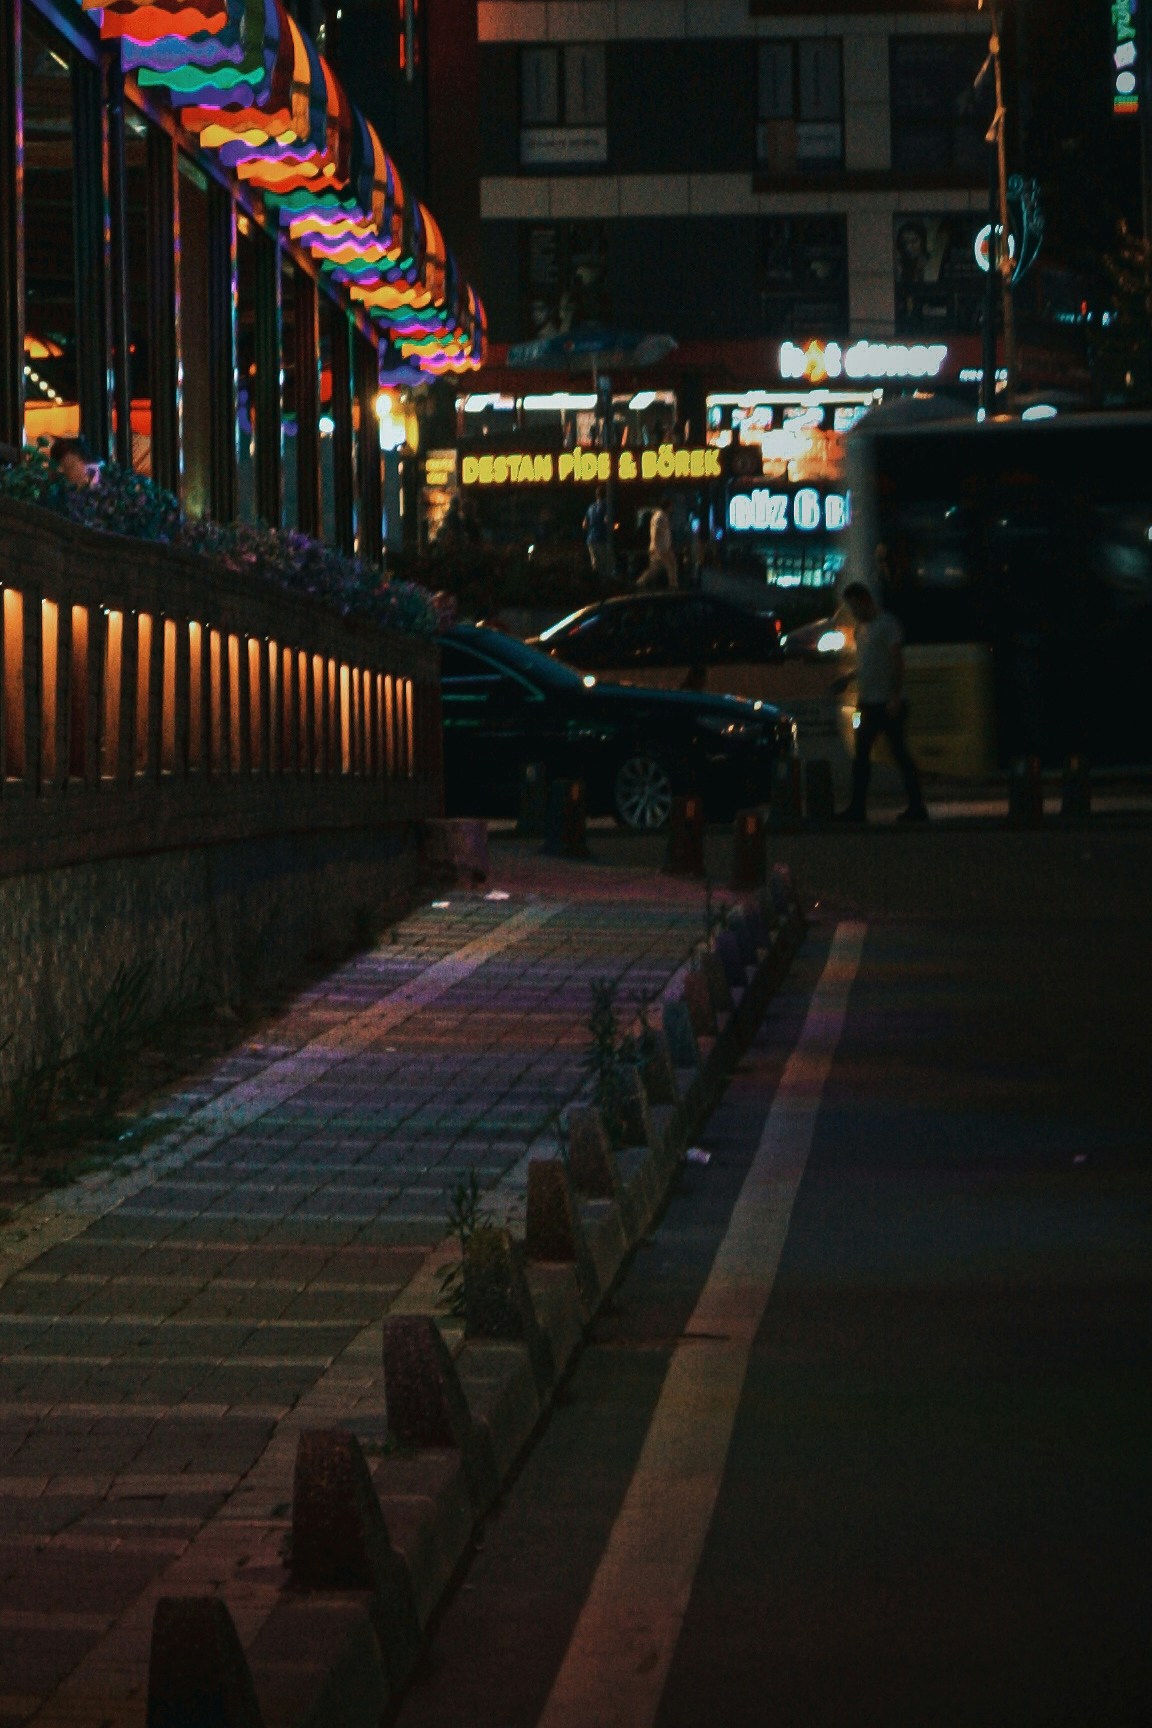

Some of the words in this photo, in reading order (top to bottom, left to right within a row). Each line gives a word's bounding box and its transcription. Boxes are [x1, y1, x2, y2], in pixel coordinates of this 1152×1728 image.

[461, 454, 554, 484] DESTAN
[558, 446, 611, 482] PİDE
[618, 451, 637, 480] &
[641, 444, 722, 479] BÖREK
